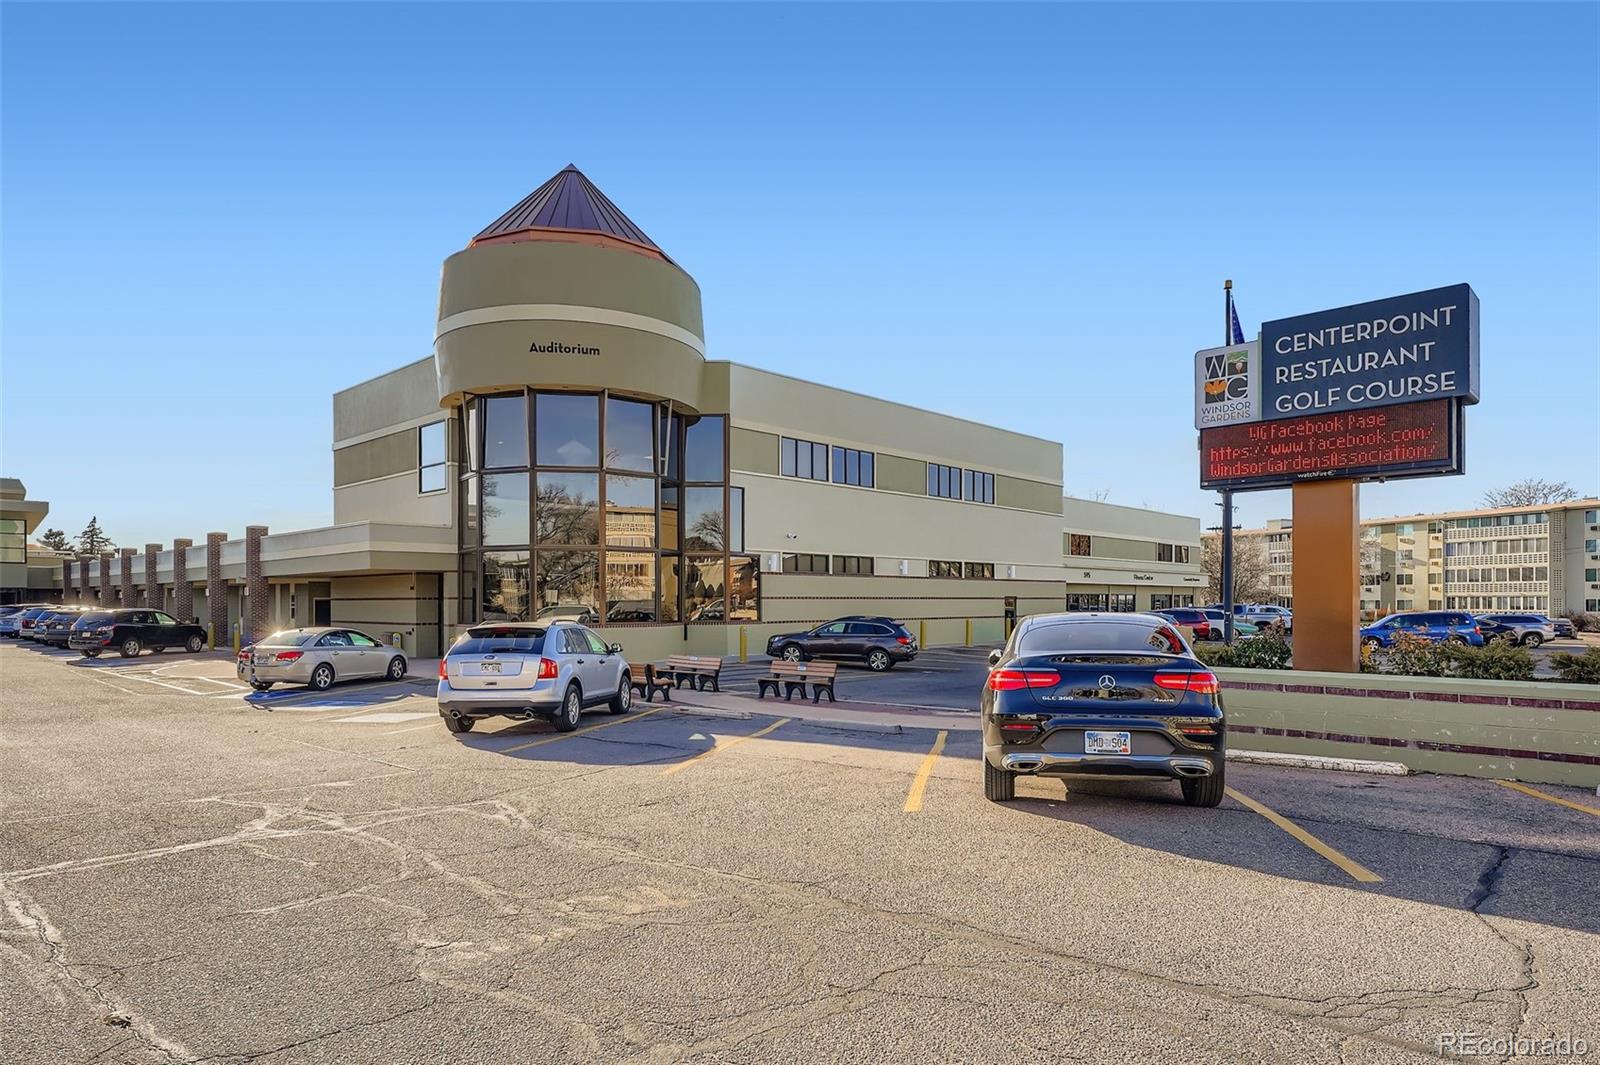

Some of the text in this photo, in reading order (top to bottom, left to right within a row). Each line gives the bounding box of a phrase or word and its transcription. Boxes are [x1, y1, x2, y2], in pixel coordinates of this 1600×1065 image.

[1274, 305, 1457, 354] CENTERPOINT
[529, 341, 600, 356] Auditorium
[1275, 341, 1436, 384] RESTAURANT
[1201, 401, 1251, 415] WINDSOR
[1275, 370, 1456, 413] GOLF COURSE
[1201, 409, 1251, 424] GARDENS
[1270, 417, 1344, 440] Facebook
[1348, 414, 1386, 430] Page
[1210, 422, 1436, 462] https://www.facebook.com/
